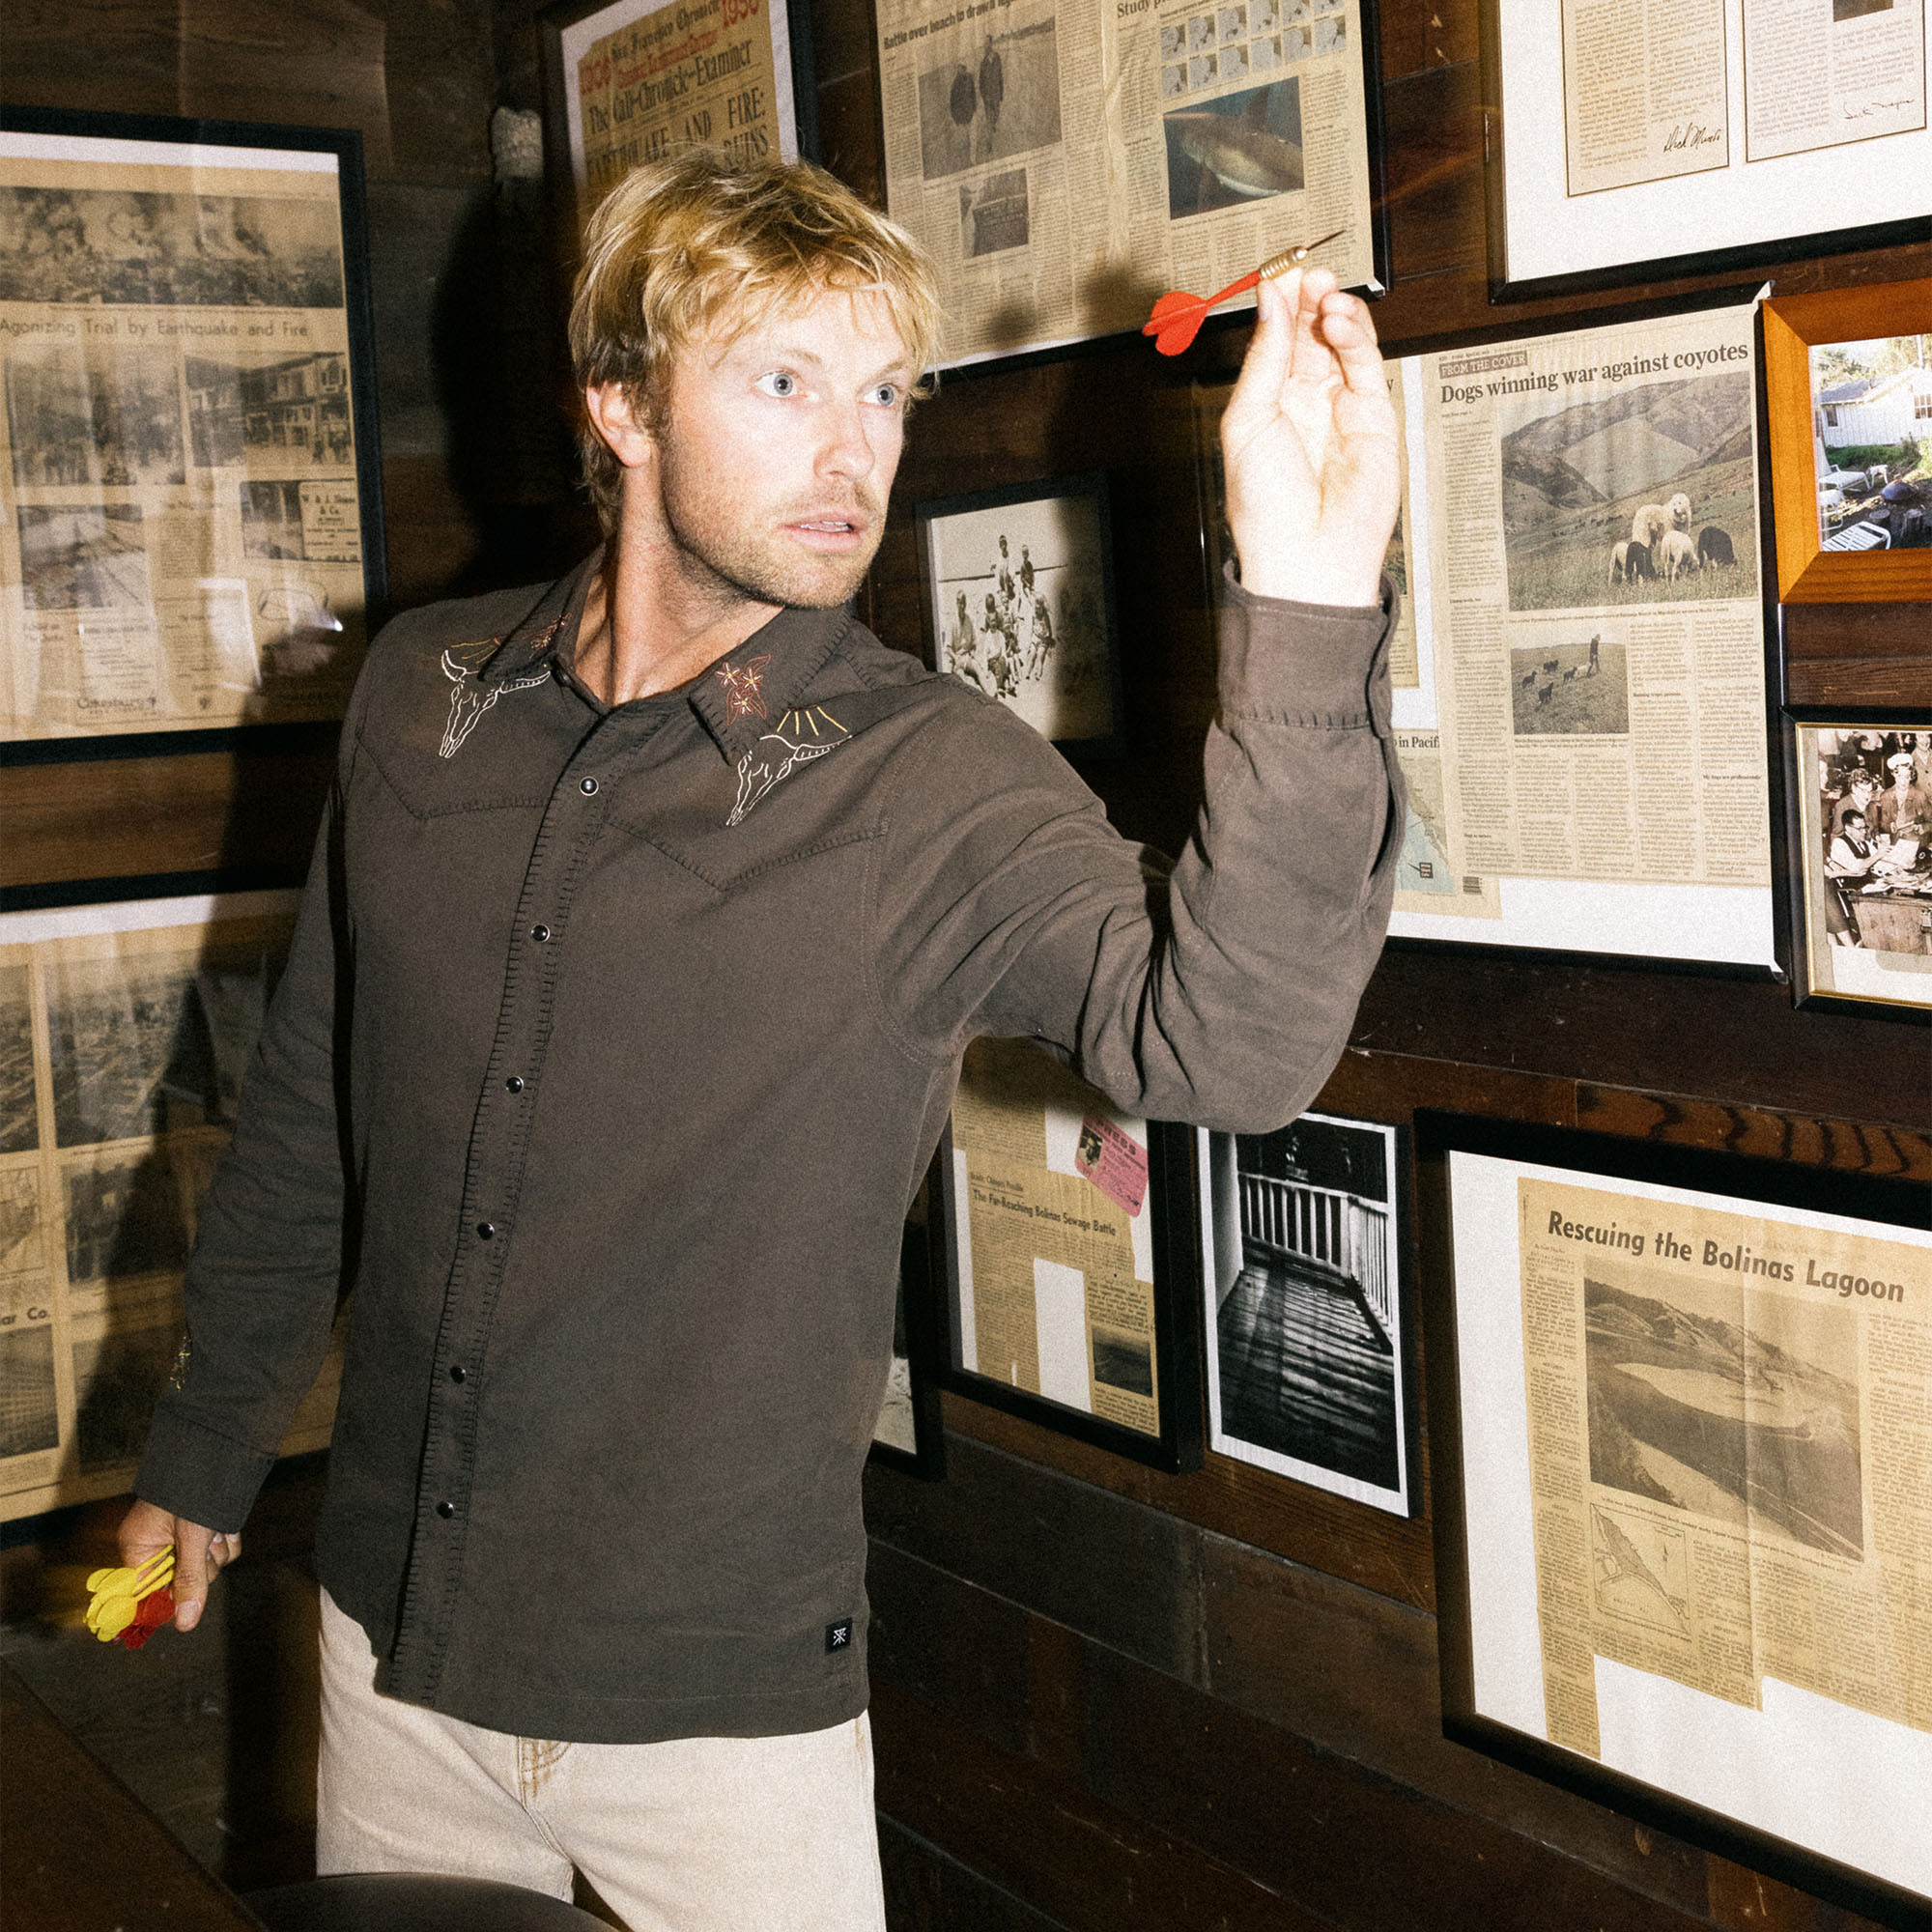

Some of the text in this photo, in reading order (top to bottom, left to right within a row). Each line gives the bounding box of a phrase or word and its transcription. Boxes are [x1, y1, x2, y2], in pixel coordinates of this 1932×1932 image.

[1117, 0, 1150, 18] Study
[908, 24, 928, 40] over
[929, 12, 956, 34] beach
[684, 110, 712, 146] AND
[0, 318, 309, 339] Agonizing Trial by Earthquake and Fire
[1440, 355, 1526, 377] FROM THE COVER
[1440, 343, 1749, 404] Dogs winning war against coyotes
[1399, 735, 1409, 749] in
[1411, 735, 1439, 749] Pacif
[972, 1188, 987, 1203] The
[1063, 1211, 1091, 1232] Sewage
[1093, 1219, 1117, 1236] Battle
[1548, 1209, 1905, 1303] Rescuing the Bolinas Lagoon
[0, 1315, 17, 1326] ar
